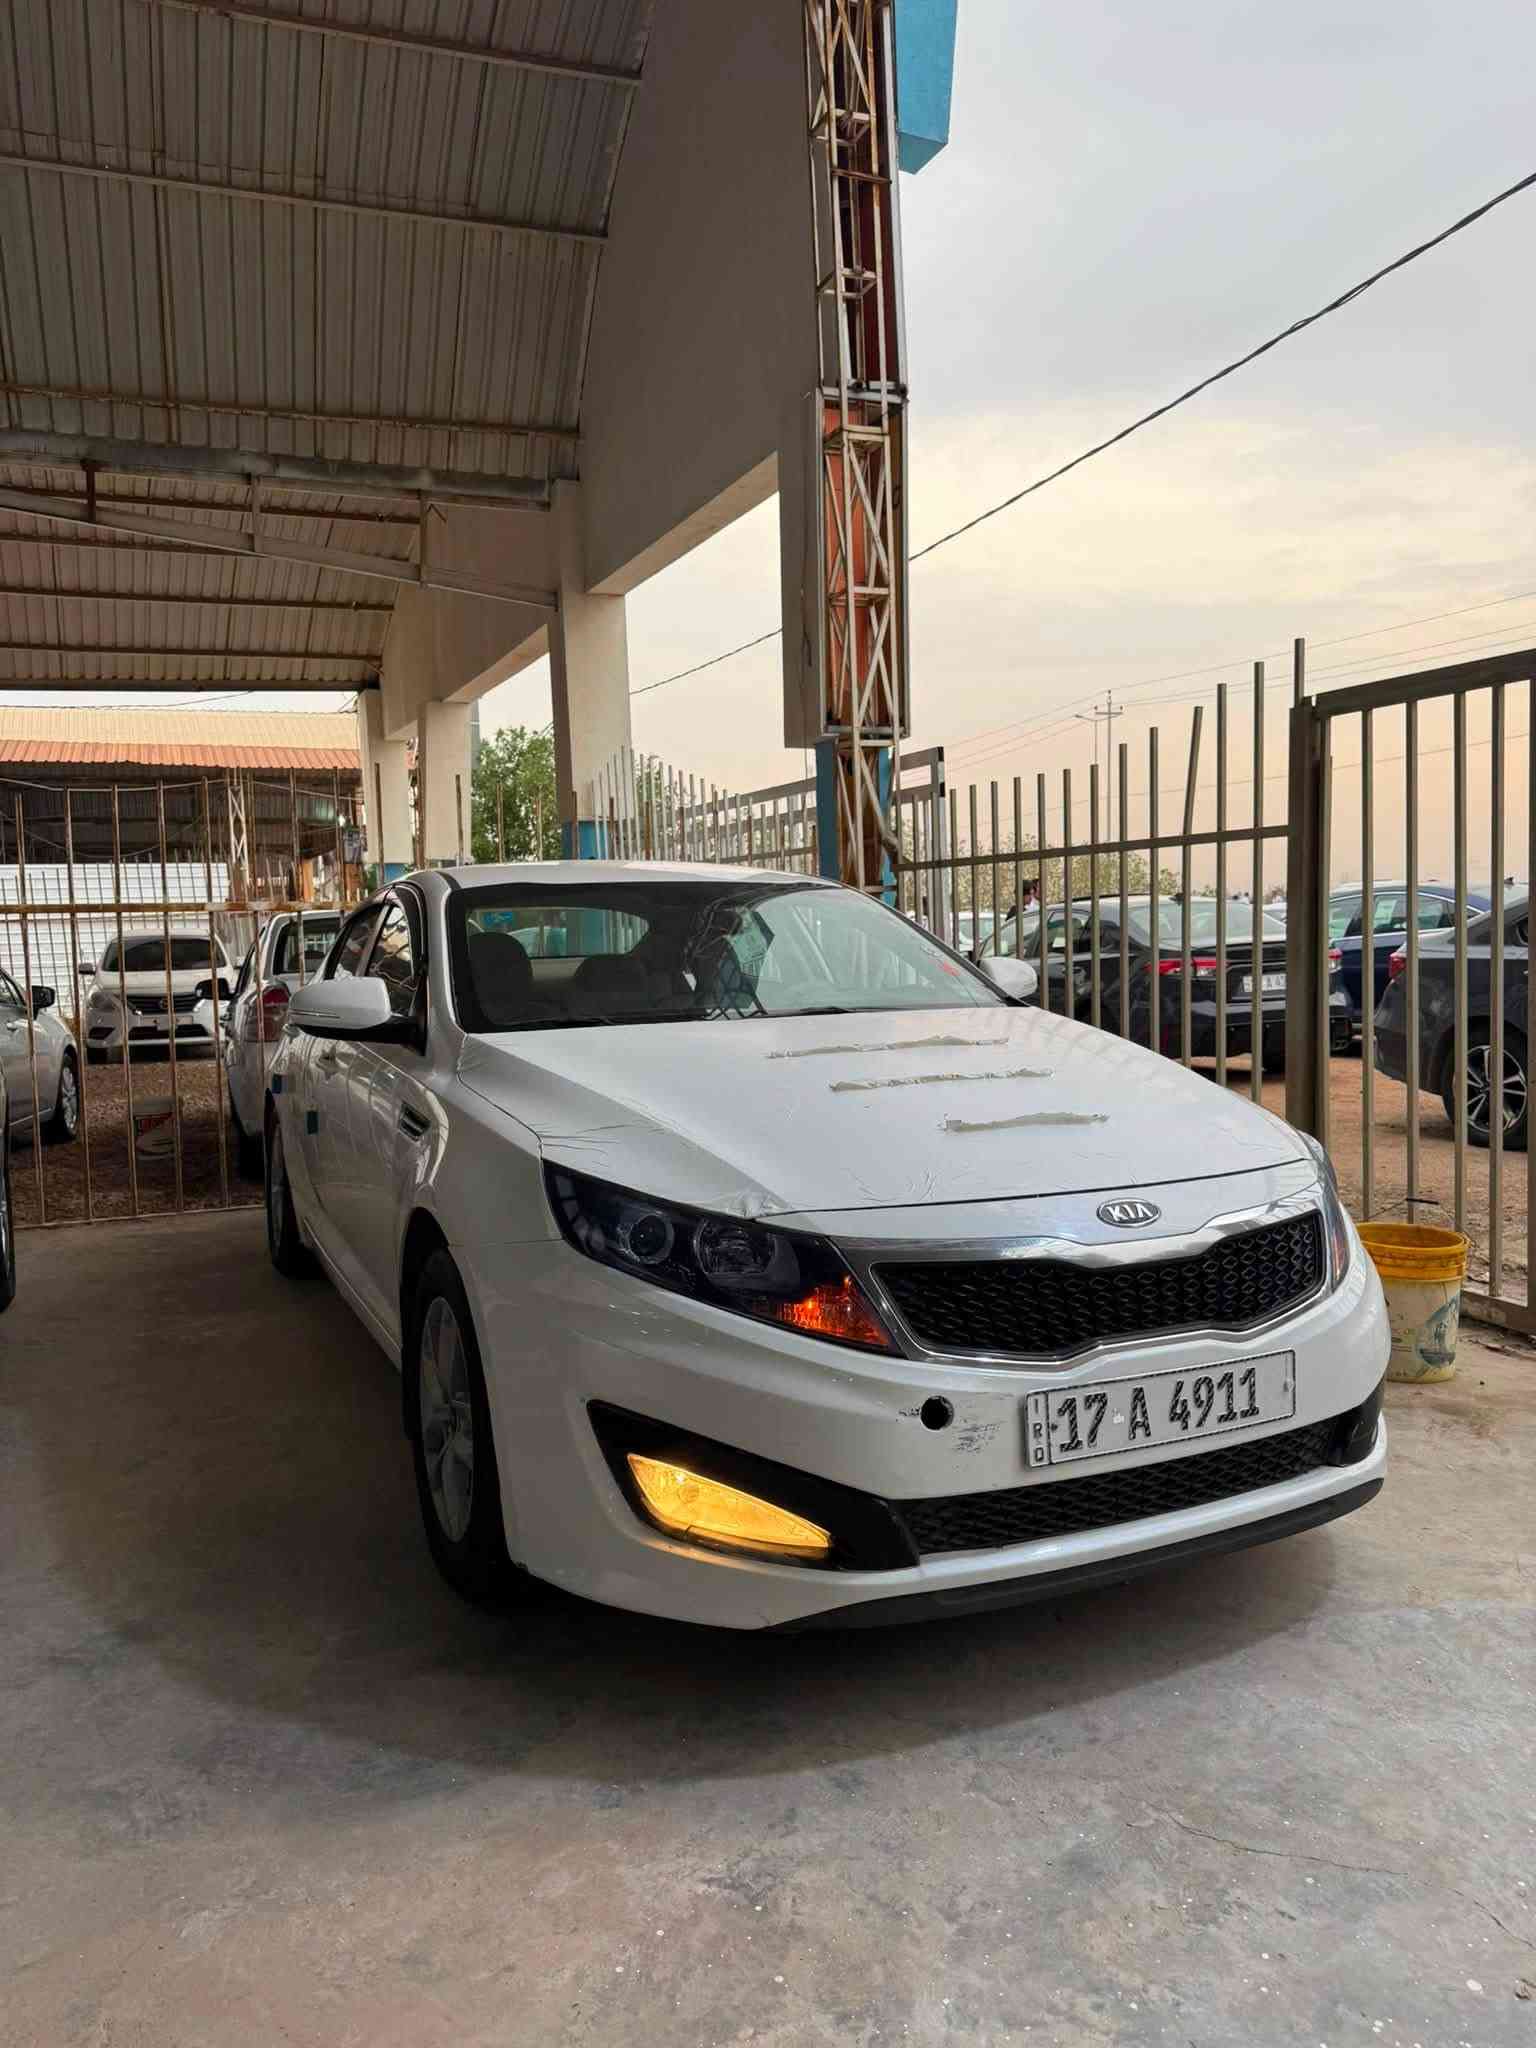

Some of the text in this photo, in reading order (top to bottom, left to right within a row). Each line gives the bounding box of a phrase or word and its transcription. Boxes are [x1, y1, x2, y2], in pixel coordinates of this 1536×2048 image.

[1107, 1203, 1153, 1222] KIA
[1057, 1367, 1260, 1452] 17 A 4911
